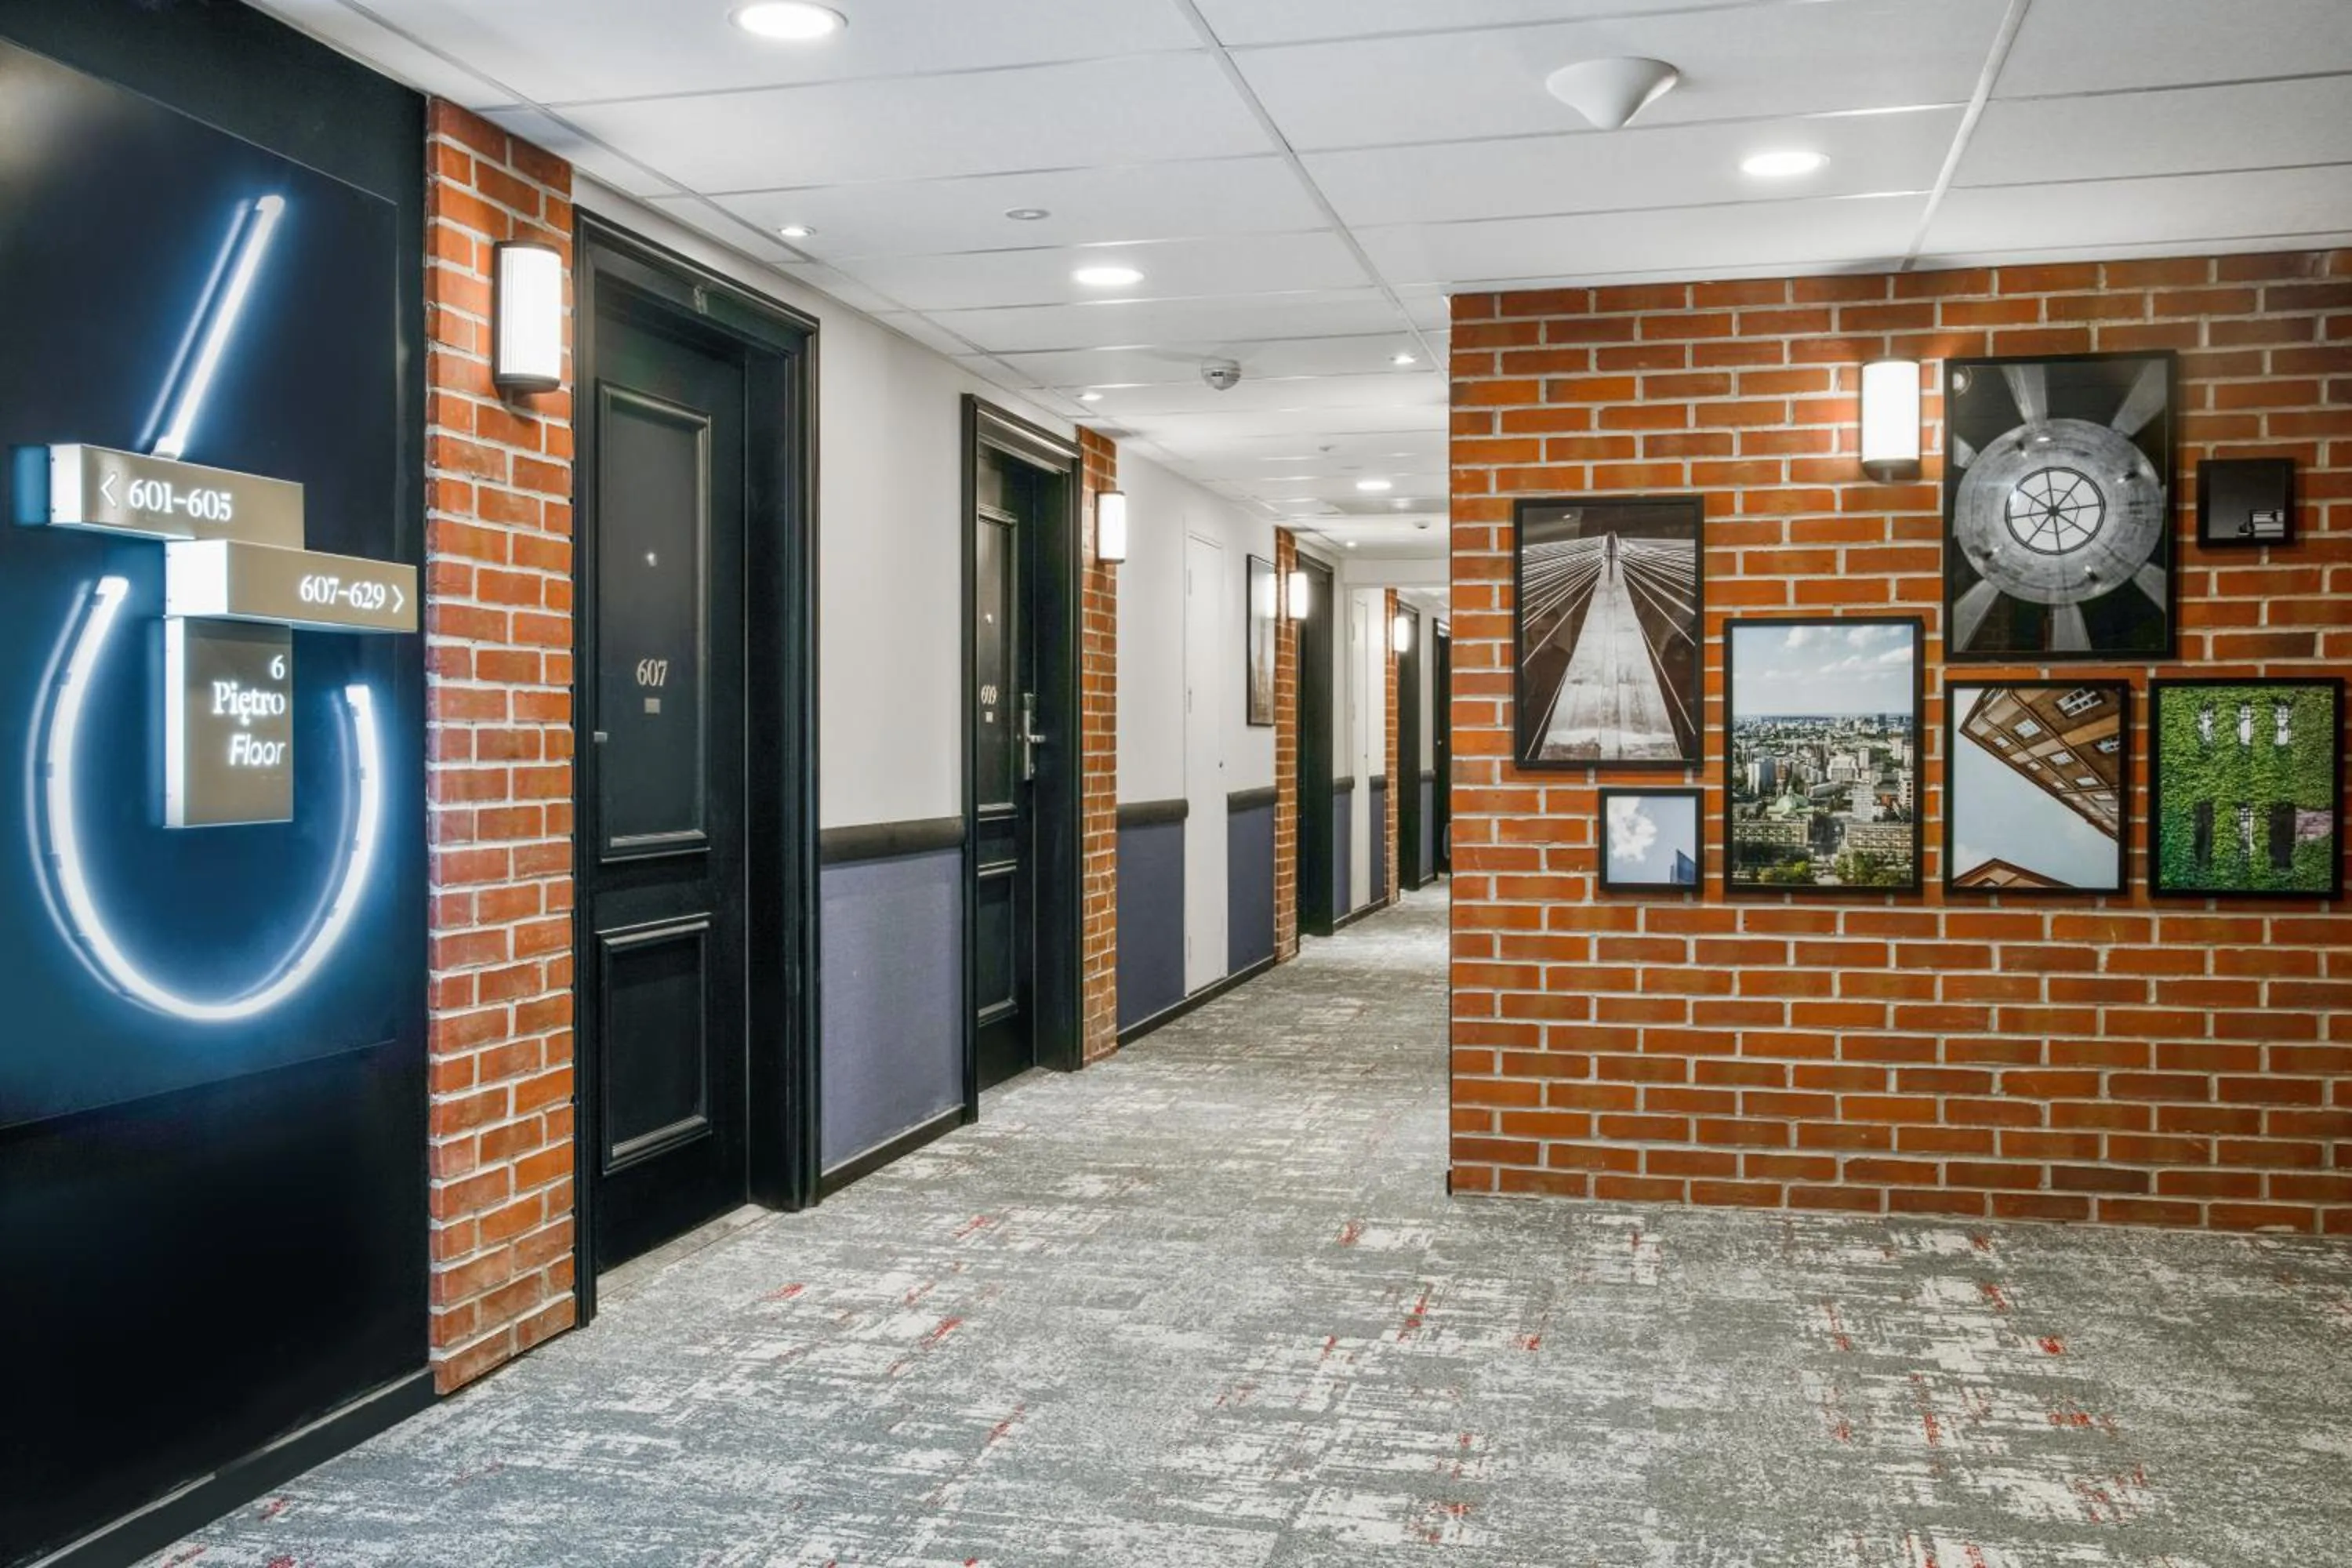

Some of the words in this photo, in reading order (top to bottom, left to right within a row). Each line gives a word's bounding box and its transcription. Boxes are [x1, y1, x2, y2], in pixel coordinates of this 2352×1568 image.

[129, 478, 232, 521] 601-605
[299, 574, 386, 610] 607-629
[270, 655, 285, 680] 6
[636, 659, 668, 687] 607
[212, 681, 285, 725] Piętro
[228, 732, 286, 766] Floor
